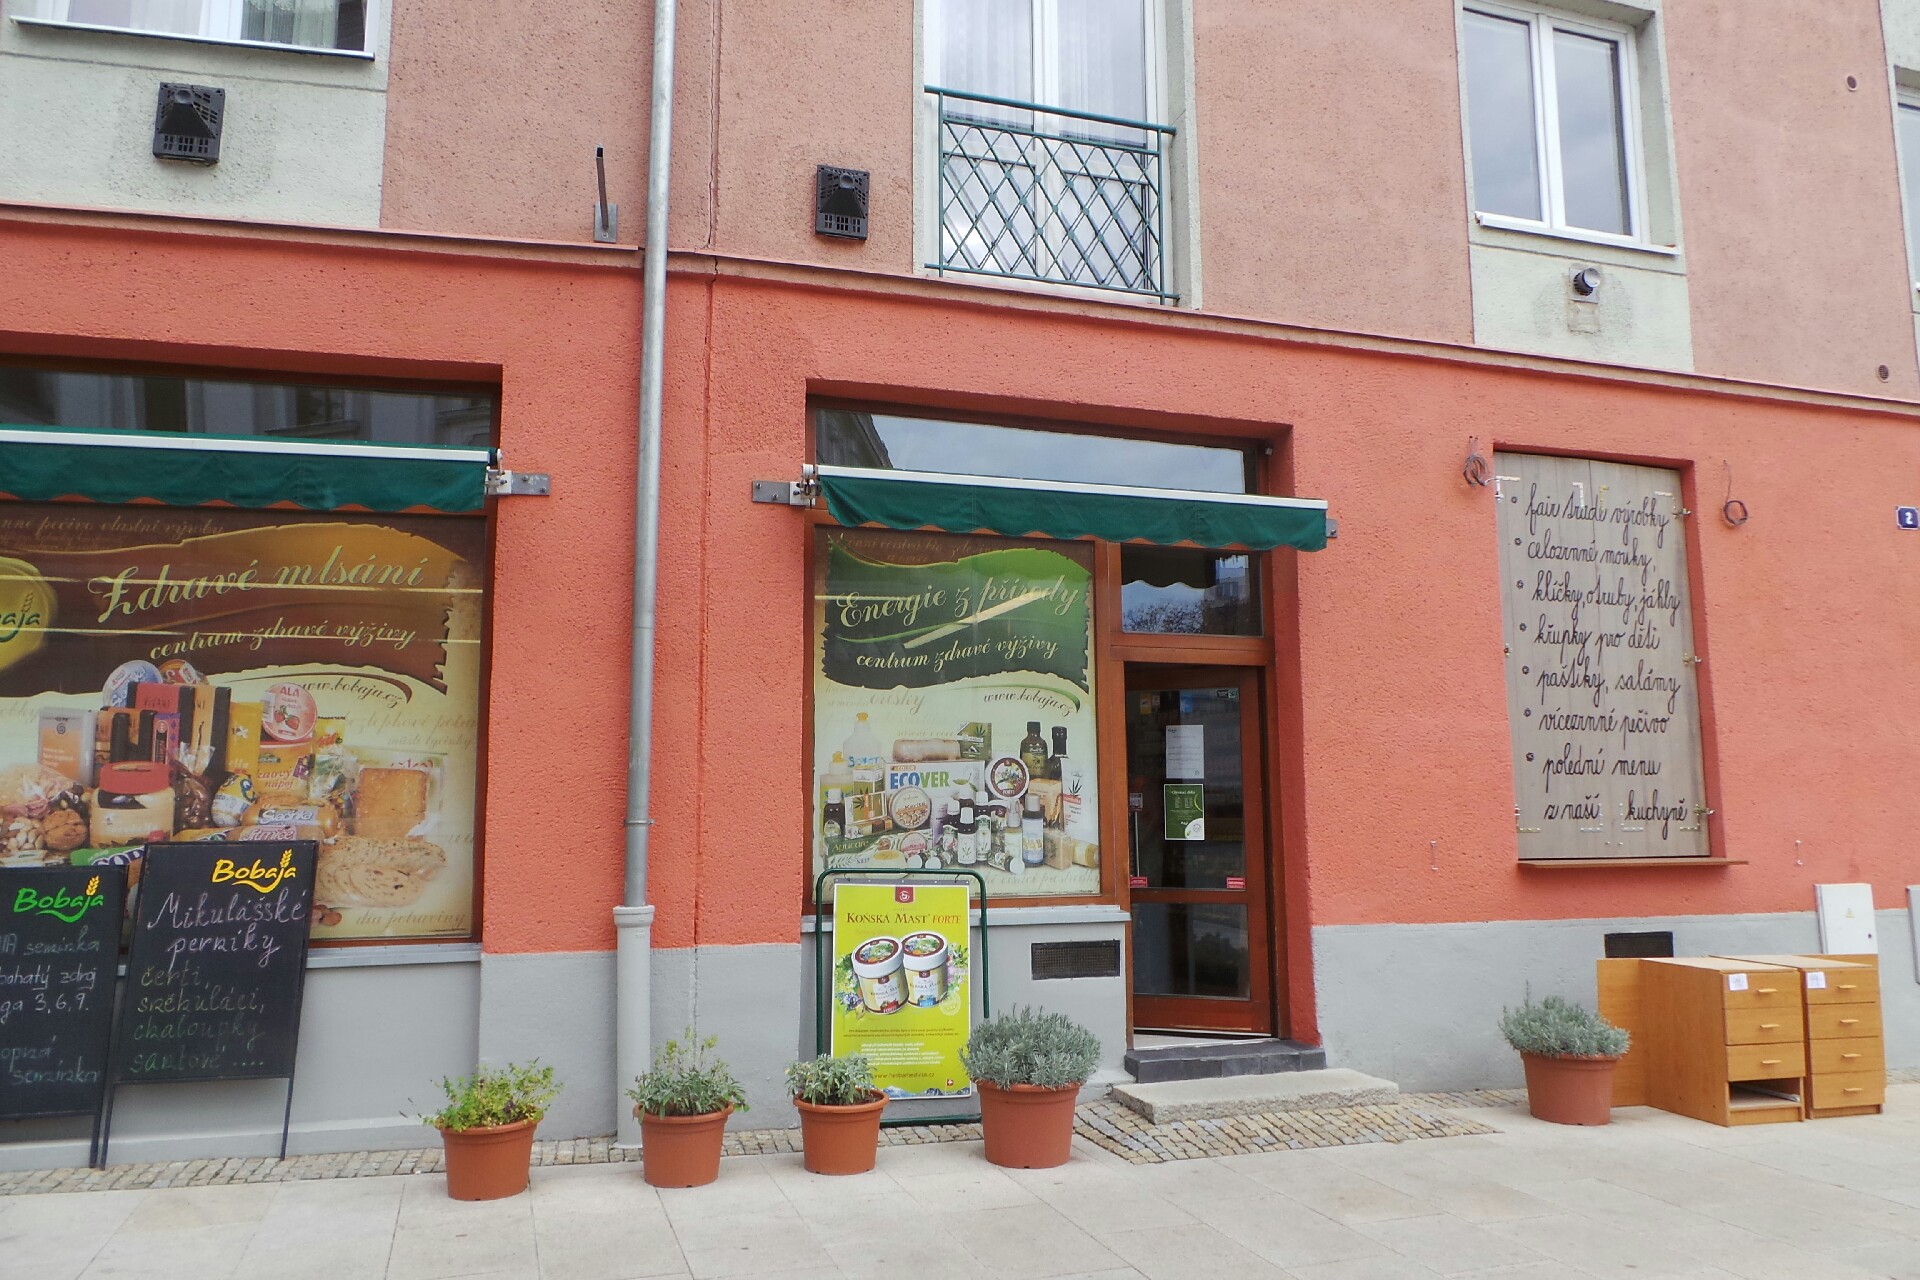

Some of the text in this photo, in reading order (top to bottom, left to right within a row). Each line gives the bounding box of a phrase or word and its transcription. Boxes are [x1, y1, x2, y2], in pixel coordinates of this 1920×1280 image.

[1525, 483, 1669, 549] fair trade výrobky
[1905, 511, 1914, 525] 2
[1527, 528, 1656, 587] celozrnné mouky,
[87, 545, 428, 623] Zdravé mlsání
[836, 574, 1079, 627] Energie z přírody
[1532, 570, 1681, 627] klíčky, otruby, jáhly
[150, 617, 416, 660] centrum zdravé výživy
[856, 635, 1059, 673] centrum zdravé výživy
[1533, 613, 1660, 666] křupky pro děti
[280, 686, 300, 697] ALA
[983, 688, 1075, 717] www.bobaja.cz
[1536, 656, 1682, 714] paštiky, salámy
[1539, 707, 1670, 750] vícezrnné pečivo
[890, 771, 950, 790] ECOVER
[1542, 742, 1662, 793] polední menu
[1543, 789, 1688, 840] z naší kuchyně
[212, 857, 296, 894] Bobaja
[13, 885, 104, 923] Bobaja
[147, 887, 307, 930] Mikulášské
[847, 911, 890, 924] KOŇSKÁ
[932, 915, 962, 924] FORTE
[168, 922, 281, 973] perníky
[0, 963, 50, 991] bohatý
